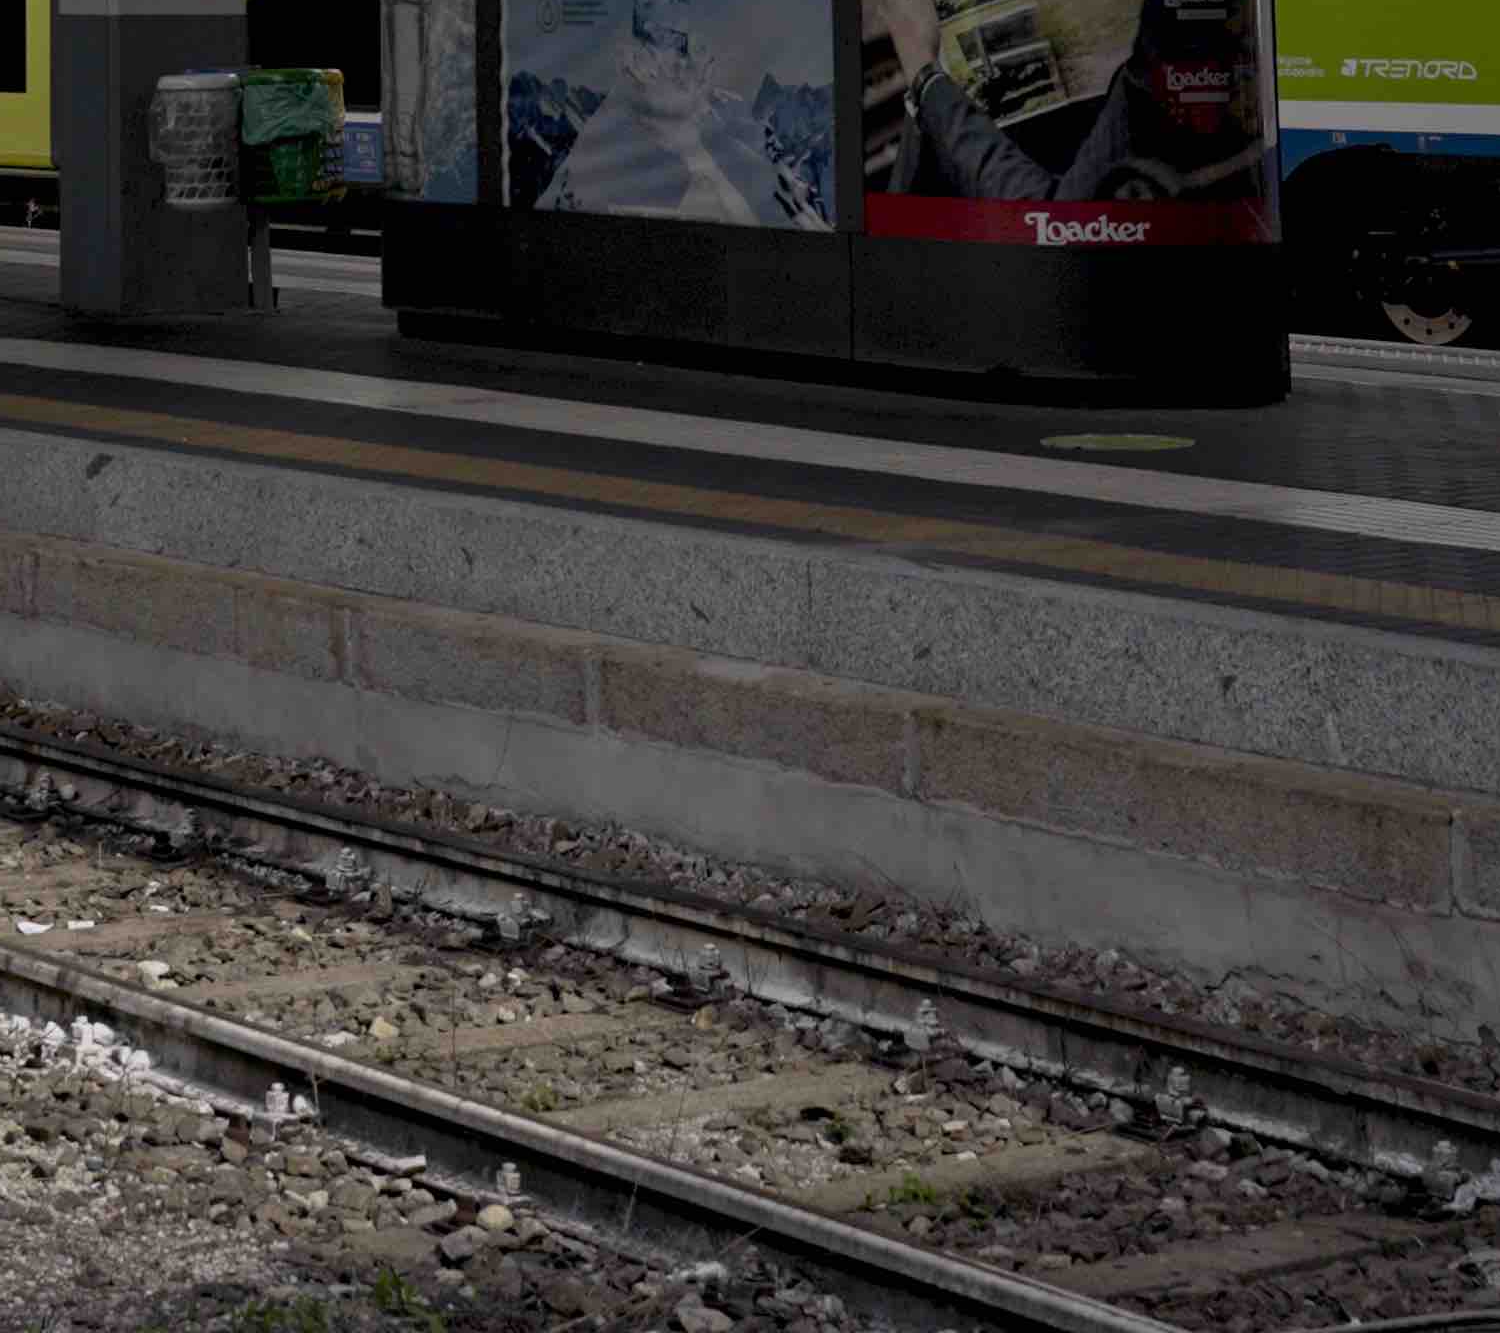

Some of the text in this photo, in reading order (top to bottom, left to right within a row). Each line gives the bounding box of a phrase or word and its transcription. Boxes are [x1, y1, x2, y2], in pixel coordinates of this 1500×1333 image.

[1161, 61, 1232, 91] Loacker
[1359, 58, 1480, 83] TRENORD
[1023, 211, 1152, 246] Loacker
